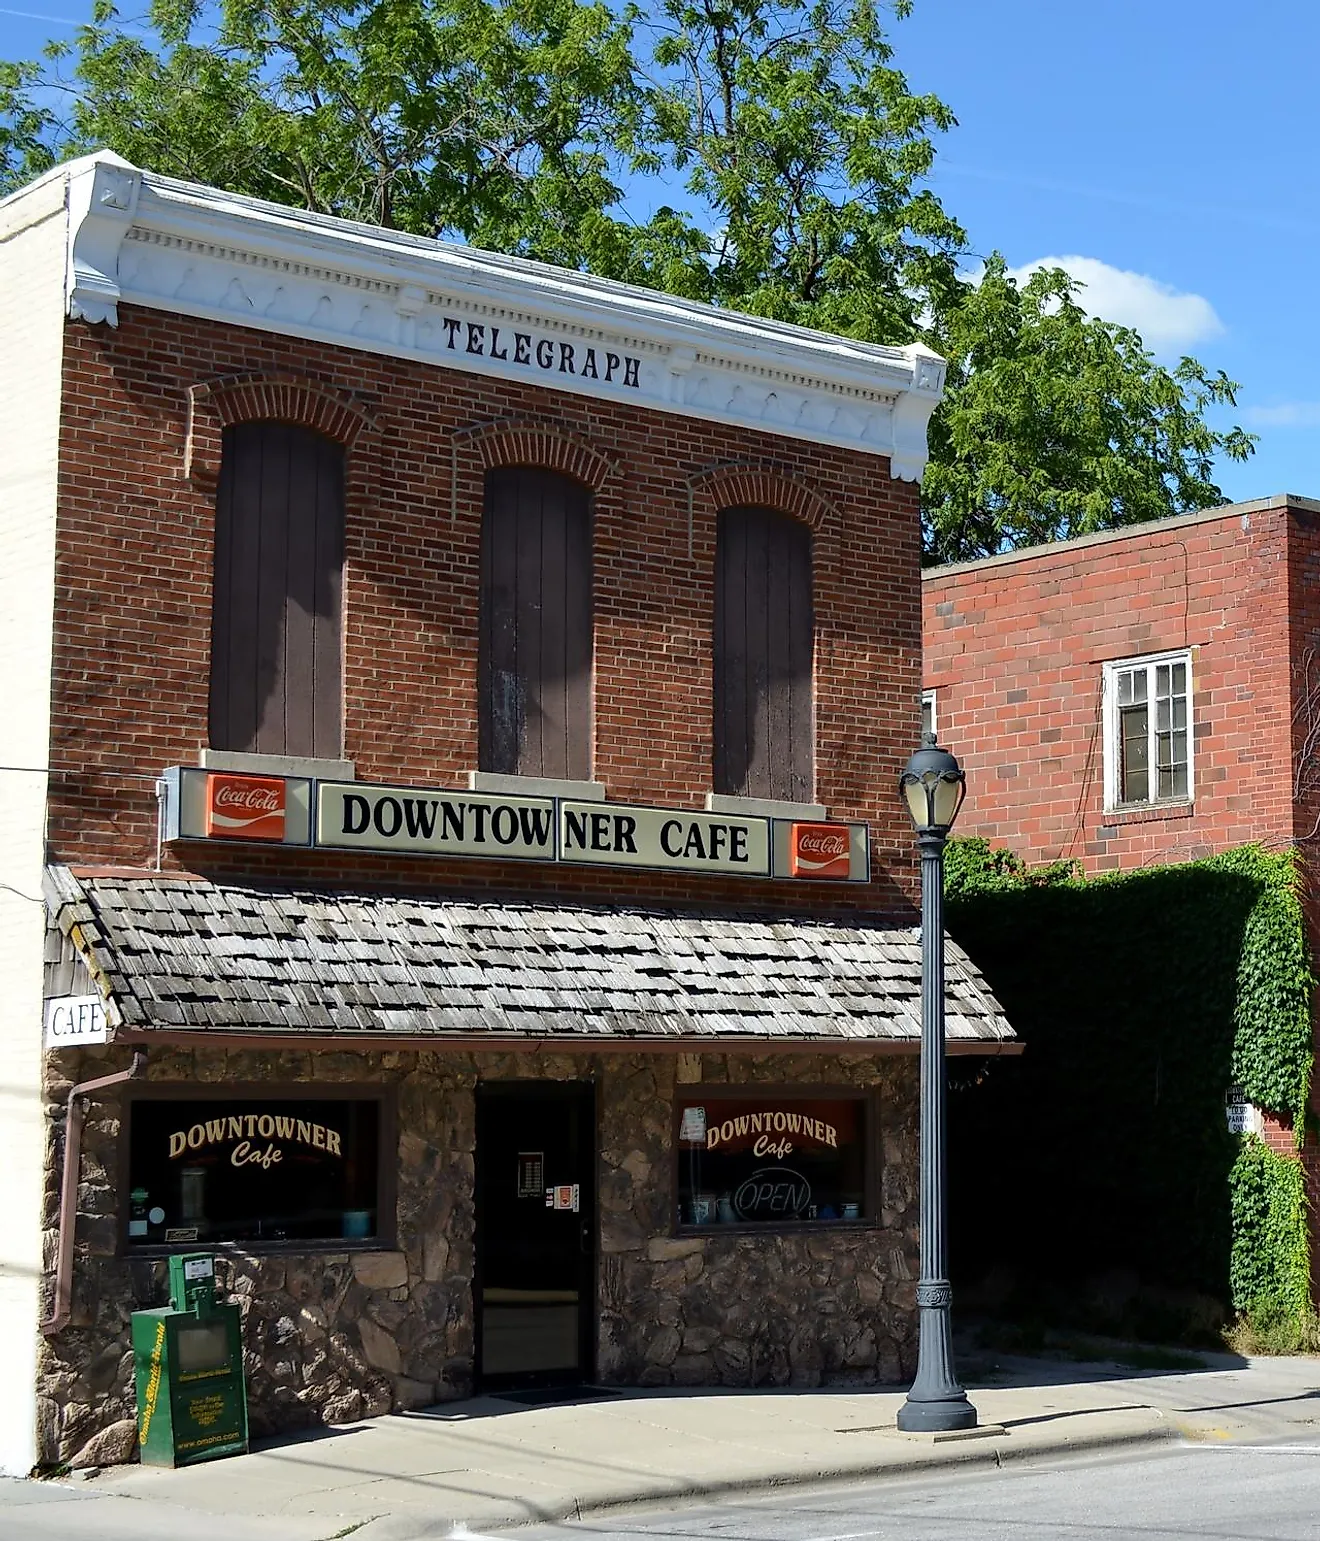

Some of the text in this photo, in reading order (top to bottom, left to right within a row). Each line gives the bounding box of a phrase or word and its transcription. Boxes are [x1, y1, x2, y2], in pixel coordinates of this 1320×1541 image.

[443, 317, 641, 388] TELEGRAPH
[215, 785, 281, 810] Coca-Cola
[342, 794, 749, 863] DOWNTOWNER CAFE
[799, 834, 845, 854] Coca-Cola
[52, 1003, 102, 1036] CAFE
[169, 1114, 342, 1158] DOWNTOWNER
[707, 1112, 838, 1150] DOWNTOWNER
[231, 1141, 283, 1169] Cafe
[753, 1135, 793, 1160] Cafe
[739, 1183, 805, 1211] OPEN
